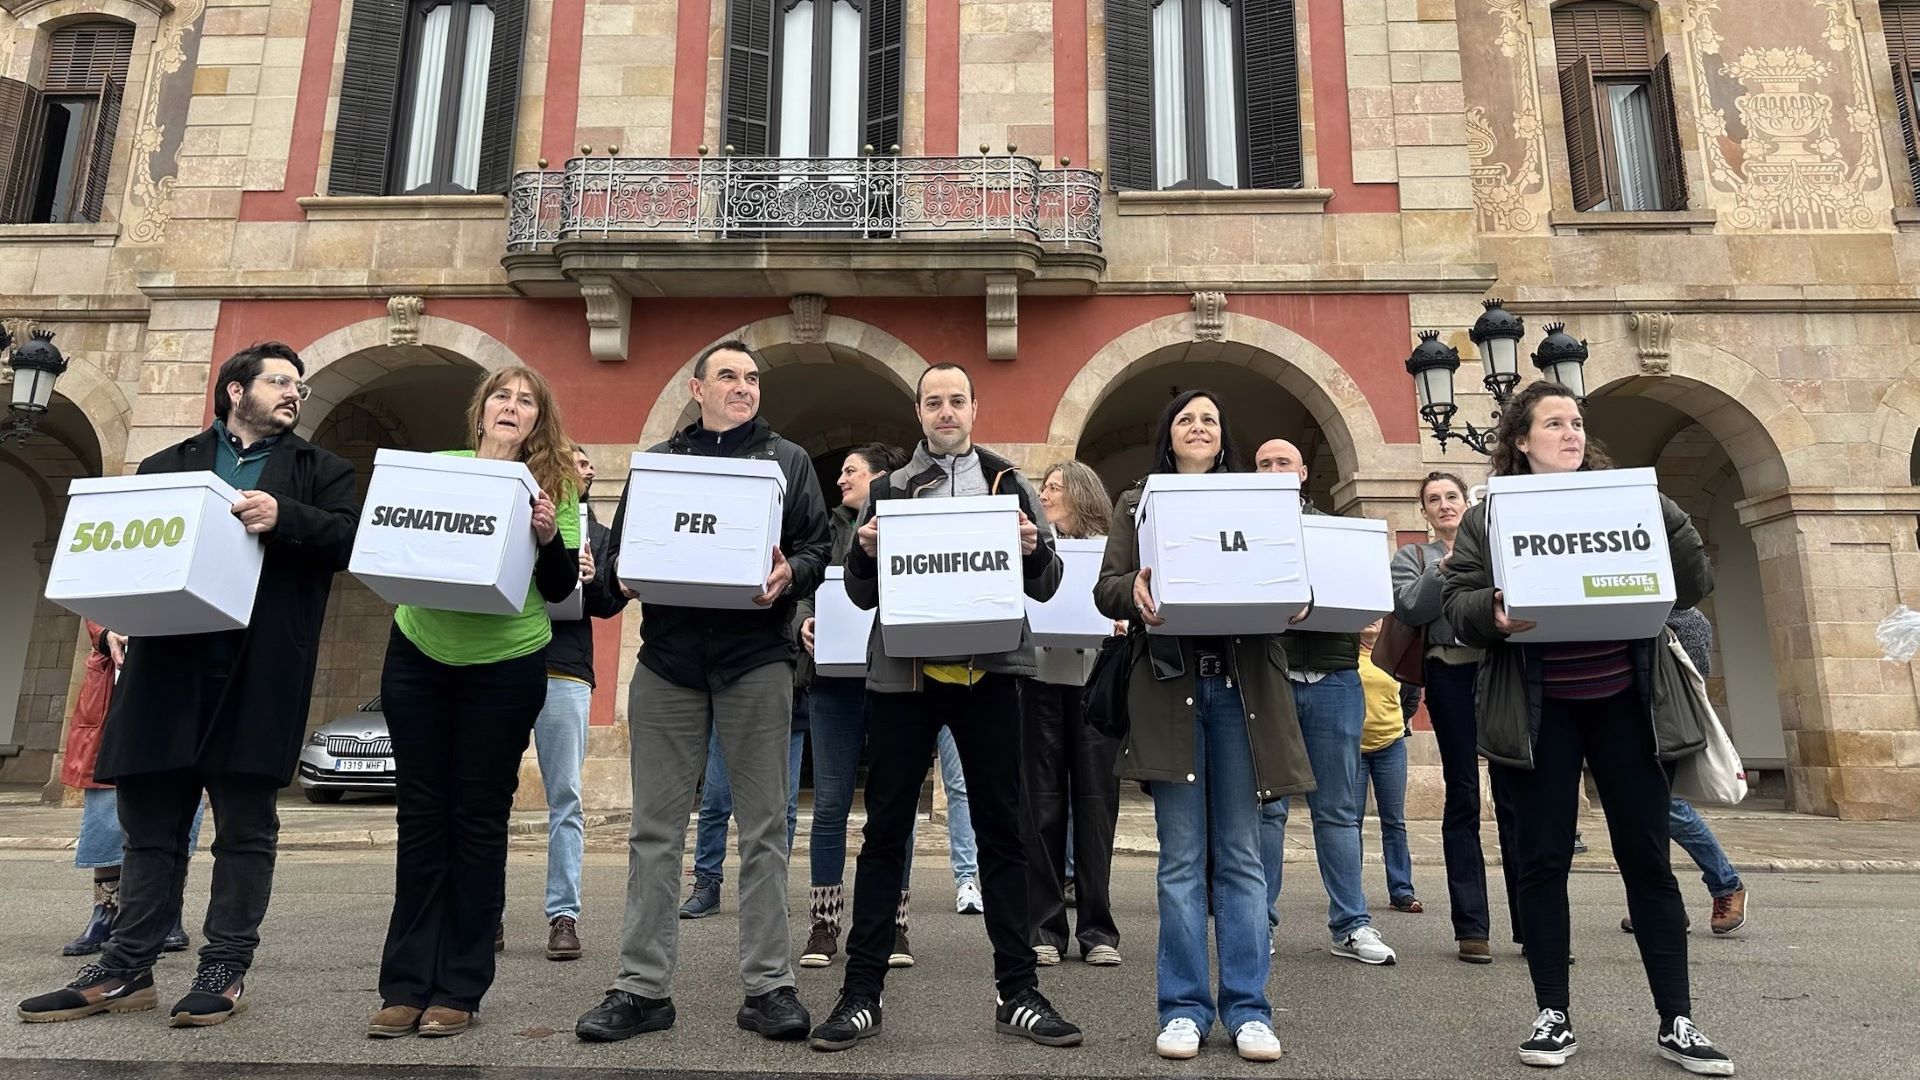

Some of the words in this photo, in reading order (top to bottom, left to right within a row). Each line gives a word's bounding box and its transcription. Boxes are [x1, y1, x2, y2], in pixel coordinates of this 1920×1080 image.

[371, 505, 497, 536] SIGNATURES
[674, 513, 717, 535] PER
[70, 516, 185, 552] 50.000
[1219, 530, 1248, 552] LA
[1512, 523, 1651, 557] PROFESSIÓ
[890, 550, 1010, 576] DIGNIFICAR
[1643, 585, 1656, 593] IAC
[343, 761, 363, 770] 1319
[366, 761, 383, 770] MHF
